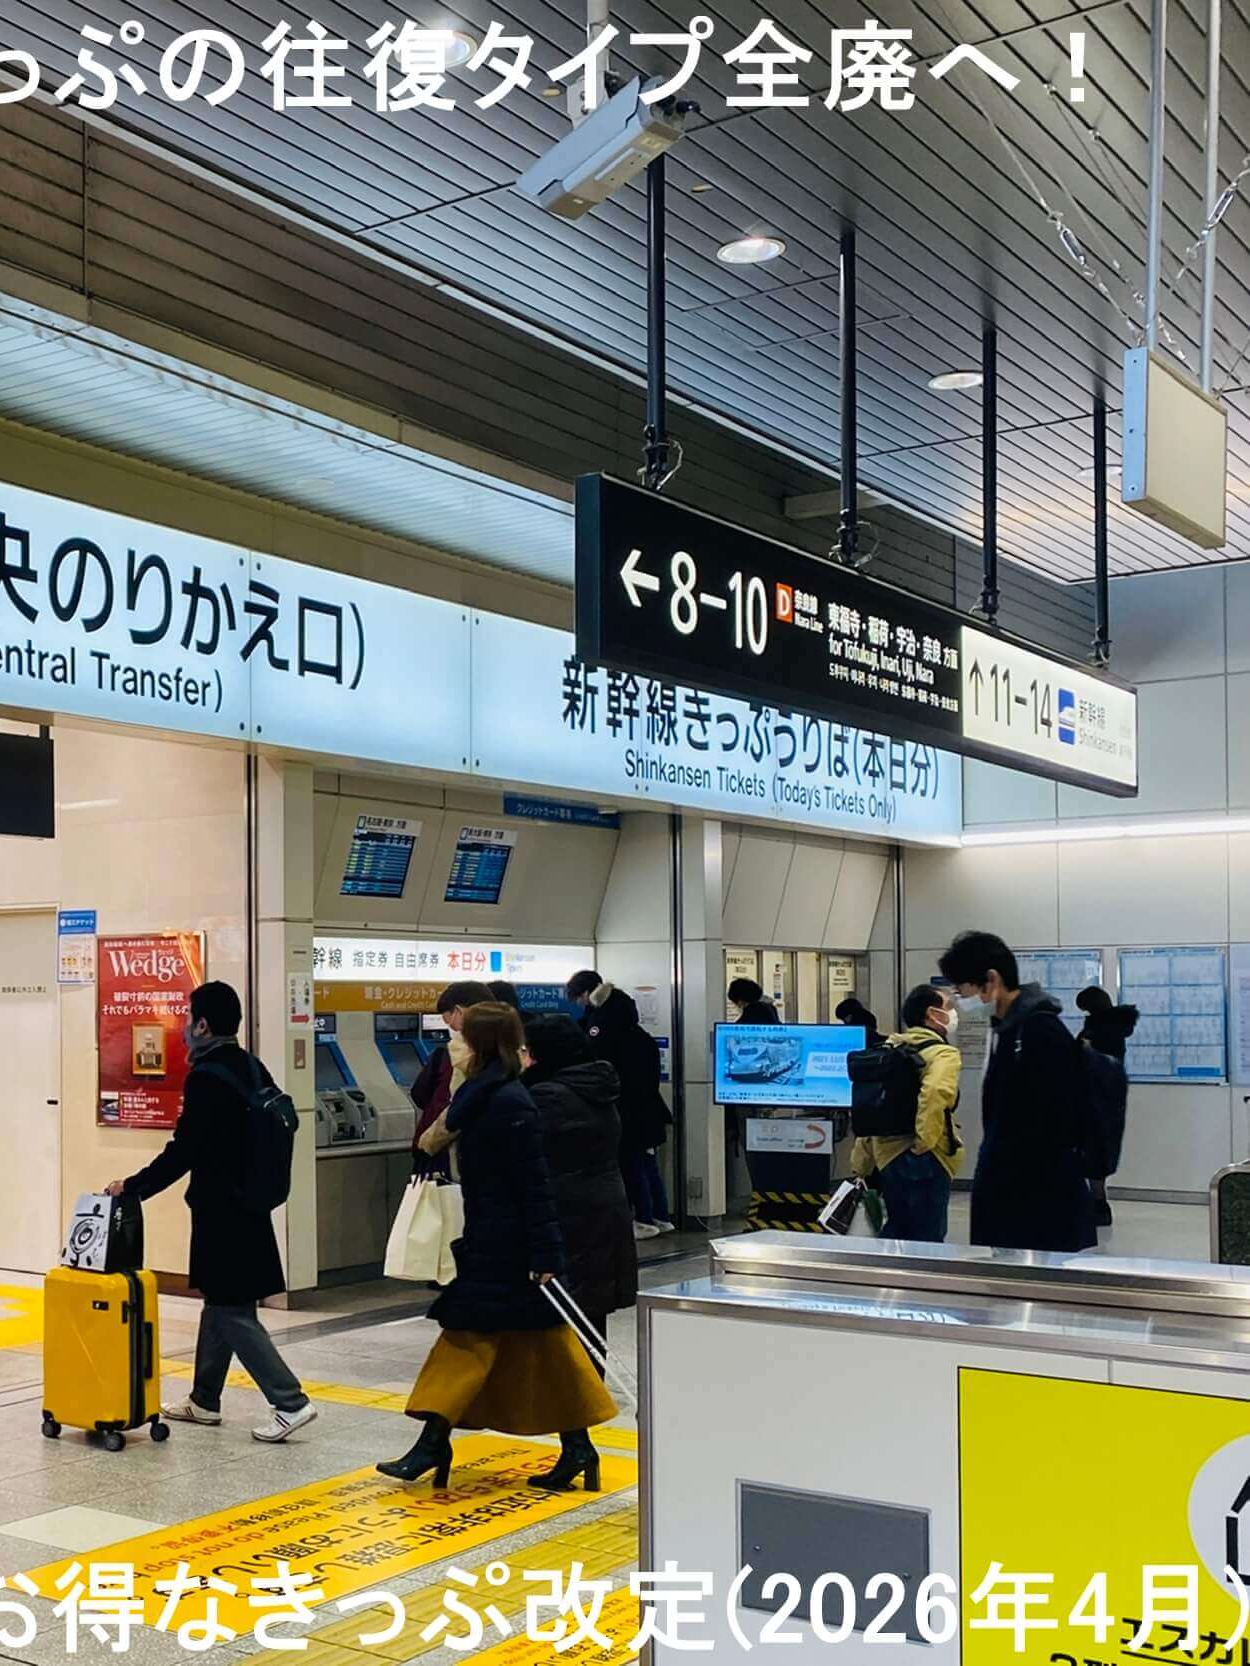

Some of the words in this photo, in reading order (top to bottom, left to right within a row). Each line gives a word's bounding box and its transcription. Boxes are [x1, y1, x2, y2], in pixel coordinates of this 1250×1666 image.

[778, 587, 789, 617] D
[829, 632, 843, 656] for
[915, 663, 934, 685] Nara
[90, 649, 223, 713] Transfer)
[625, 748, 712, 789] Shinkansen
[717, 765, 765, 799] Tickets
[772, 770, 821, 812] (Today's
[824, 785, 865, 817] Tickets
[868, 790, 897, 826] Only)
[108, 949, 185, 983] Wedge
[447, 951, 487, 971] 本日分
[234, 1531, 265, 1543] do
[261, 1511, 331, 1534] Please
[190, 1540, 234, 1555] not
